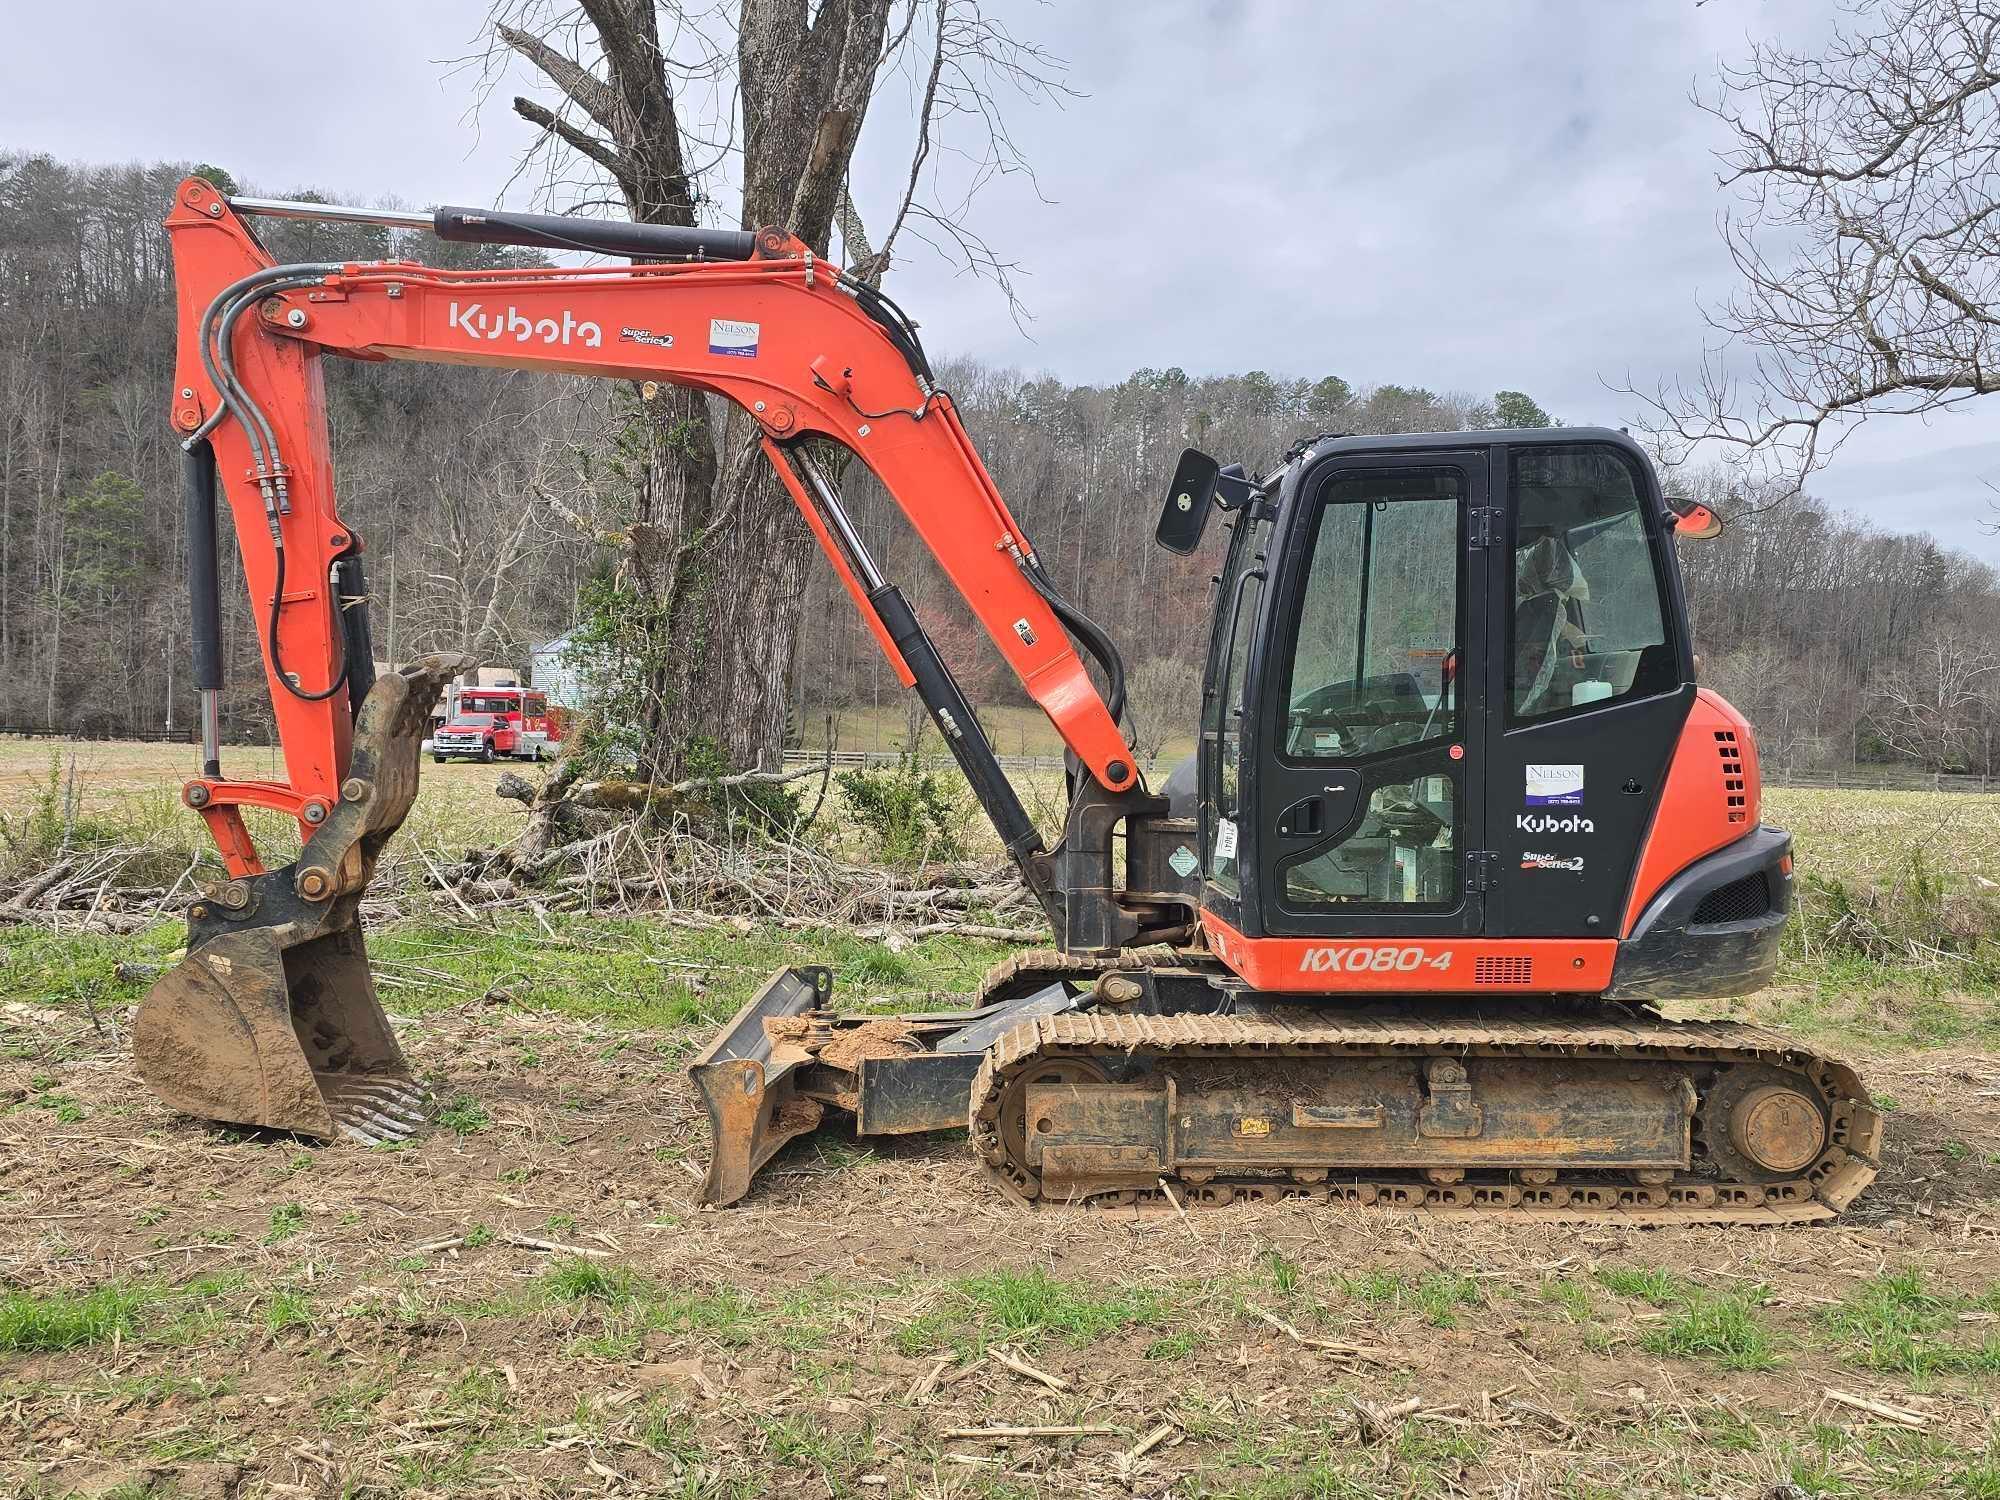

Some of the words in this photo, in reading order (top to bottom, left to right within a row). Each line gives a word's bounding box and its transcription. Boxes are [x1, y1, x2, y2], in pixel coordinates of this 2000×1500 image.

[450, 302, 602, 347] Kubota
[621, 327, 651, 338] Super
[714, 320, 757, 335] NELSON
[1516, 815, 1594, 832] Kubota
[1522, 852, 1555, 863] Super
[1300, 947, 1453, 972] KX080-4
